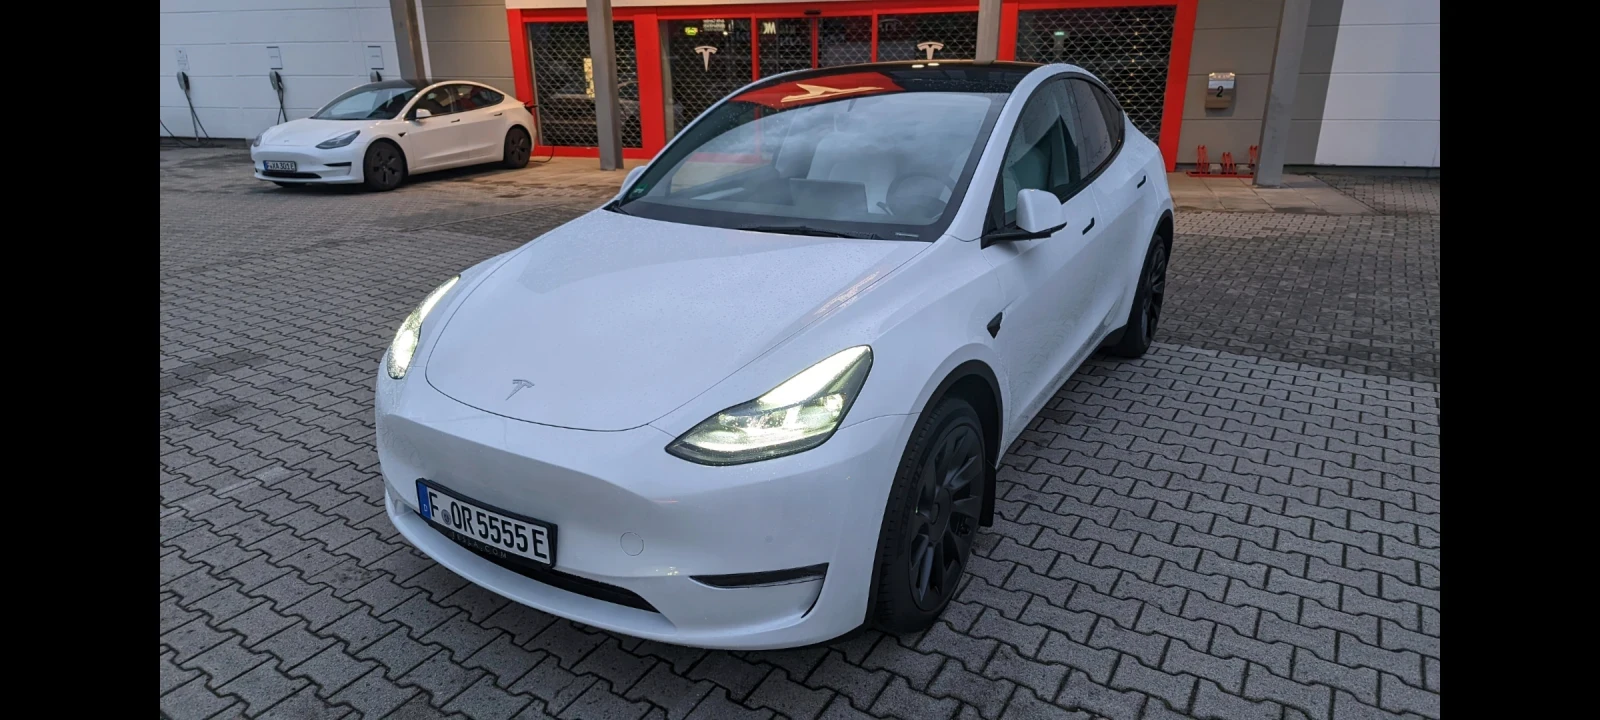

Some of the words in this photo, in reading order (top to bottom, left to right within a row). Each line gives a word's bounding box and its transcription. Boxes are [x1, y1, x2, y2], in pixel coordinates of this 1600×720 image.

[1216, 85, 1224, 98] 2
[429, 491, 439, 517] F
[476, 510, 528, 553] 5555
[532, 528, 547, 560] E
